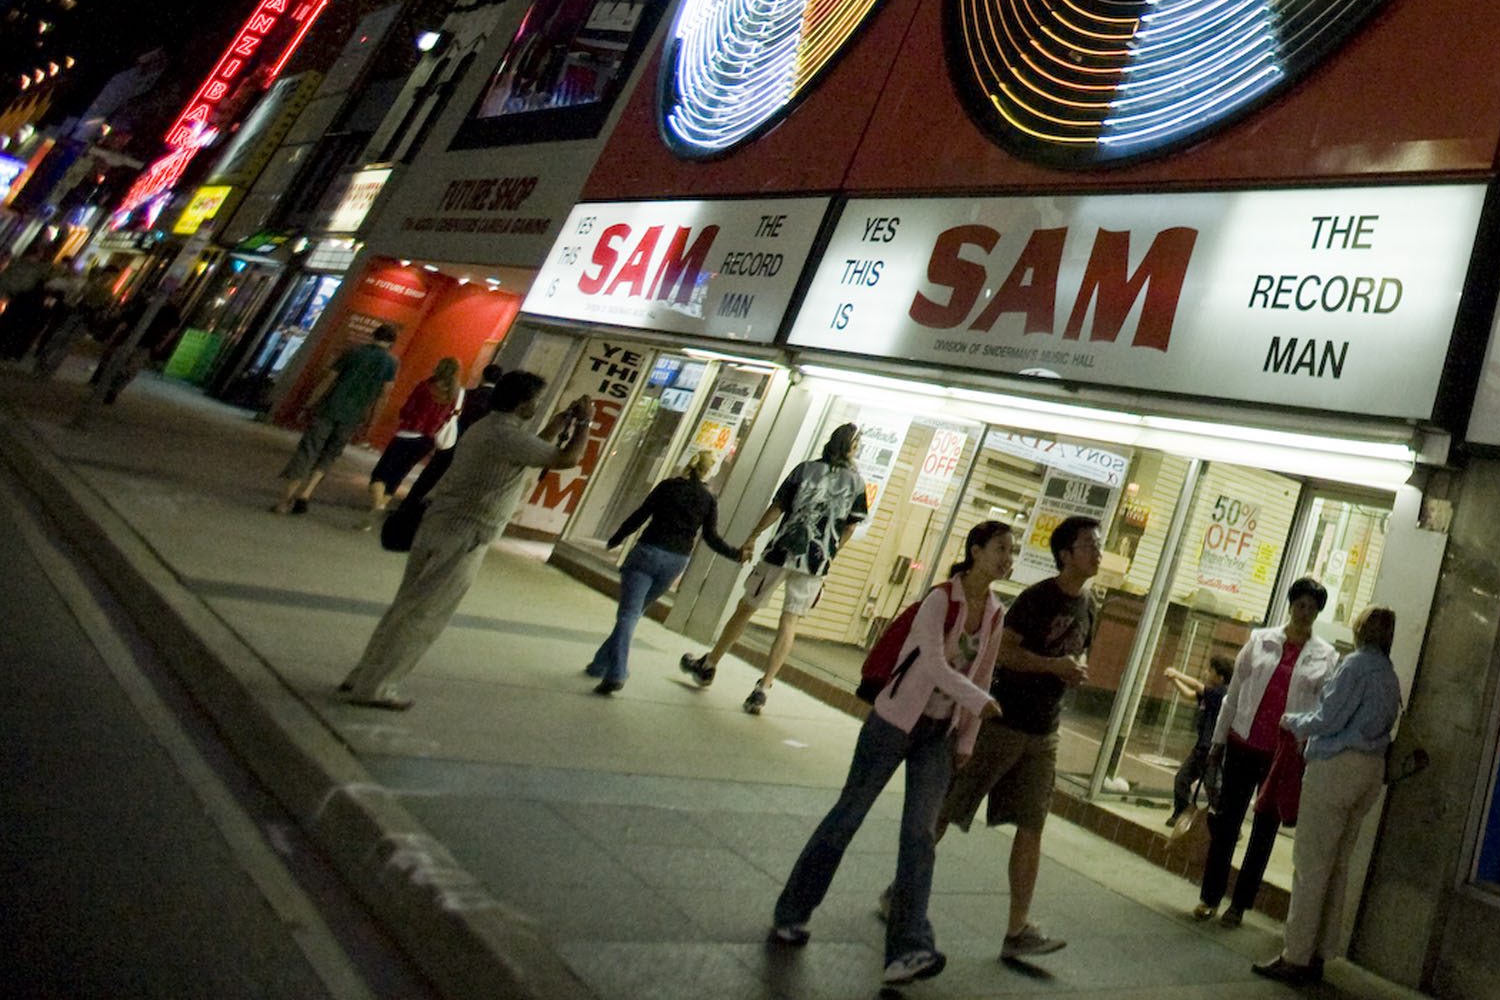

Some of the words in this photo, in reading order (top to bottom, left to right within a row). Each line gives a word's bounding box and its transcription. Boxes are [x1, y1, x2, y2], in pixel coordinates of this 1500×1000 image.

[577, 217, 597, 235] YES
[755, 215, 788, 238] THE
[861, 217, 900, 243] YES
[1312, 215, 1379, 249] THE
[578, 223, 720, 305] SAM
[720, 252, 784, 278] RECORD
[841, 260, 884, 287] THIS
[909, 224, 1199, 353] SAM
[1248, 275, 1404, 314] RECORD
[716, 294, 755, 319] MAN
[830, 303, 854, 330] IS
[933, 339, 967, 353] DIVISION
[969, 343, 982, 355] OF
[1072, 354, 1096, 368] HALL
[1262, 336, 1349, 379] MAN
[598, 379, 629, 399] IS
[931, 430, 961, 456] 50%
[923, 453, 957, 478] OFF
[1212, 494, 1257, 532] 50%
[1207, 523, 1253, 556] OFF
